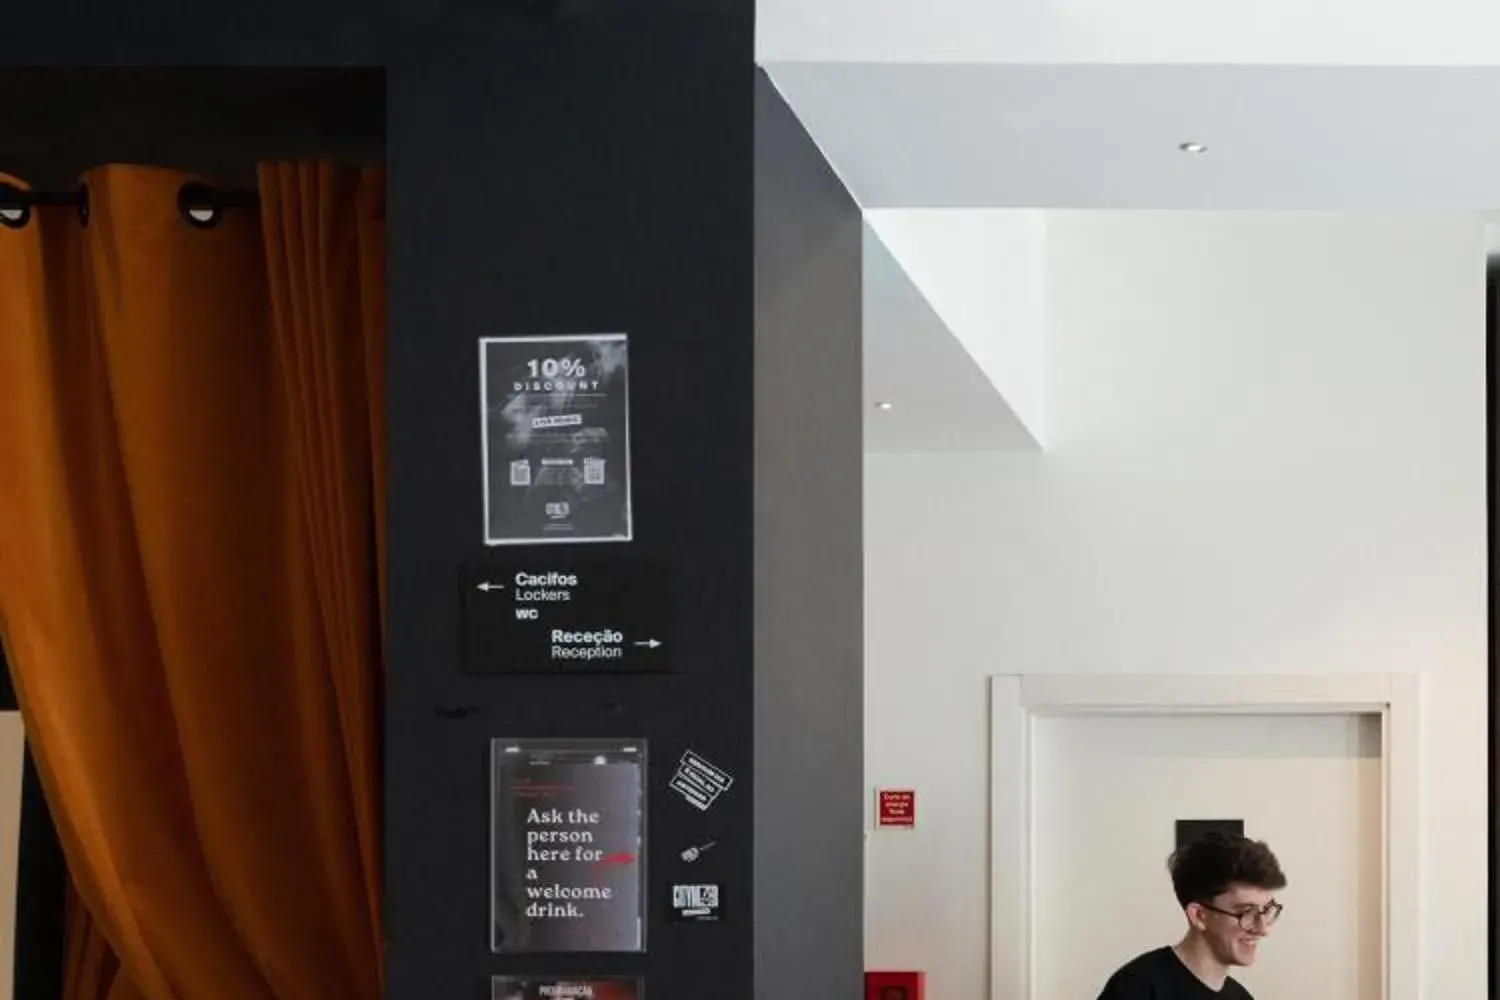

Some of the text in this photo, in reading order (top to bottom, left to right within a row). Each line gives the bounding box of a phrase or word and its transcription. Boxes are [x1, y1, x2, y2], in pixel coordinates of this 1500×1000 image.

[527, 358, 586, 378] 10%
[513, 381, 600, 392] DISCOUNT
[515, 571, 578, 587] Cacifos
[515, 588, 571, 601] Lockers
[551, 628, 623, 646] Receção
[551, 645, 623, 660] Reception
[526, 808, 601, 824] Ask the
[526, 830, 594, 849] person
[526, 846, 605, 862] here for
[525, 868, 538, 881] a
[525, 883, 613, 900] welcome
[525, 901, 585, 918] drink.
